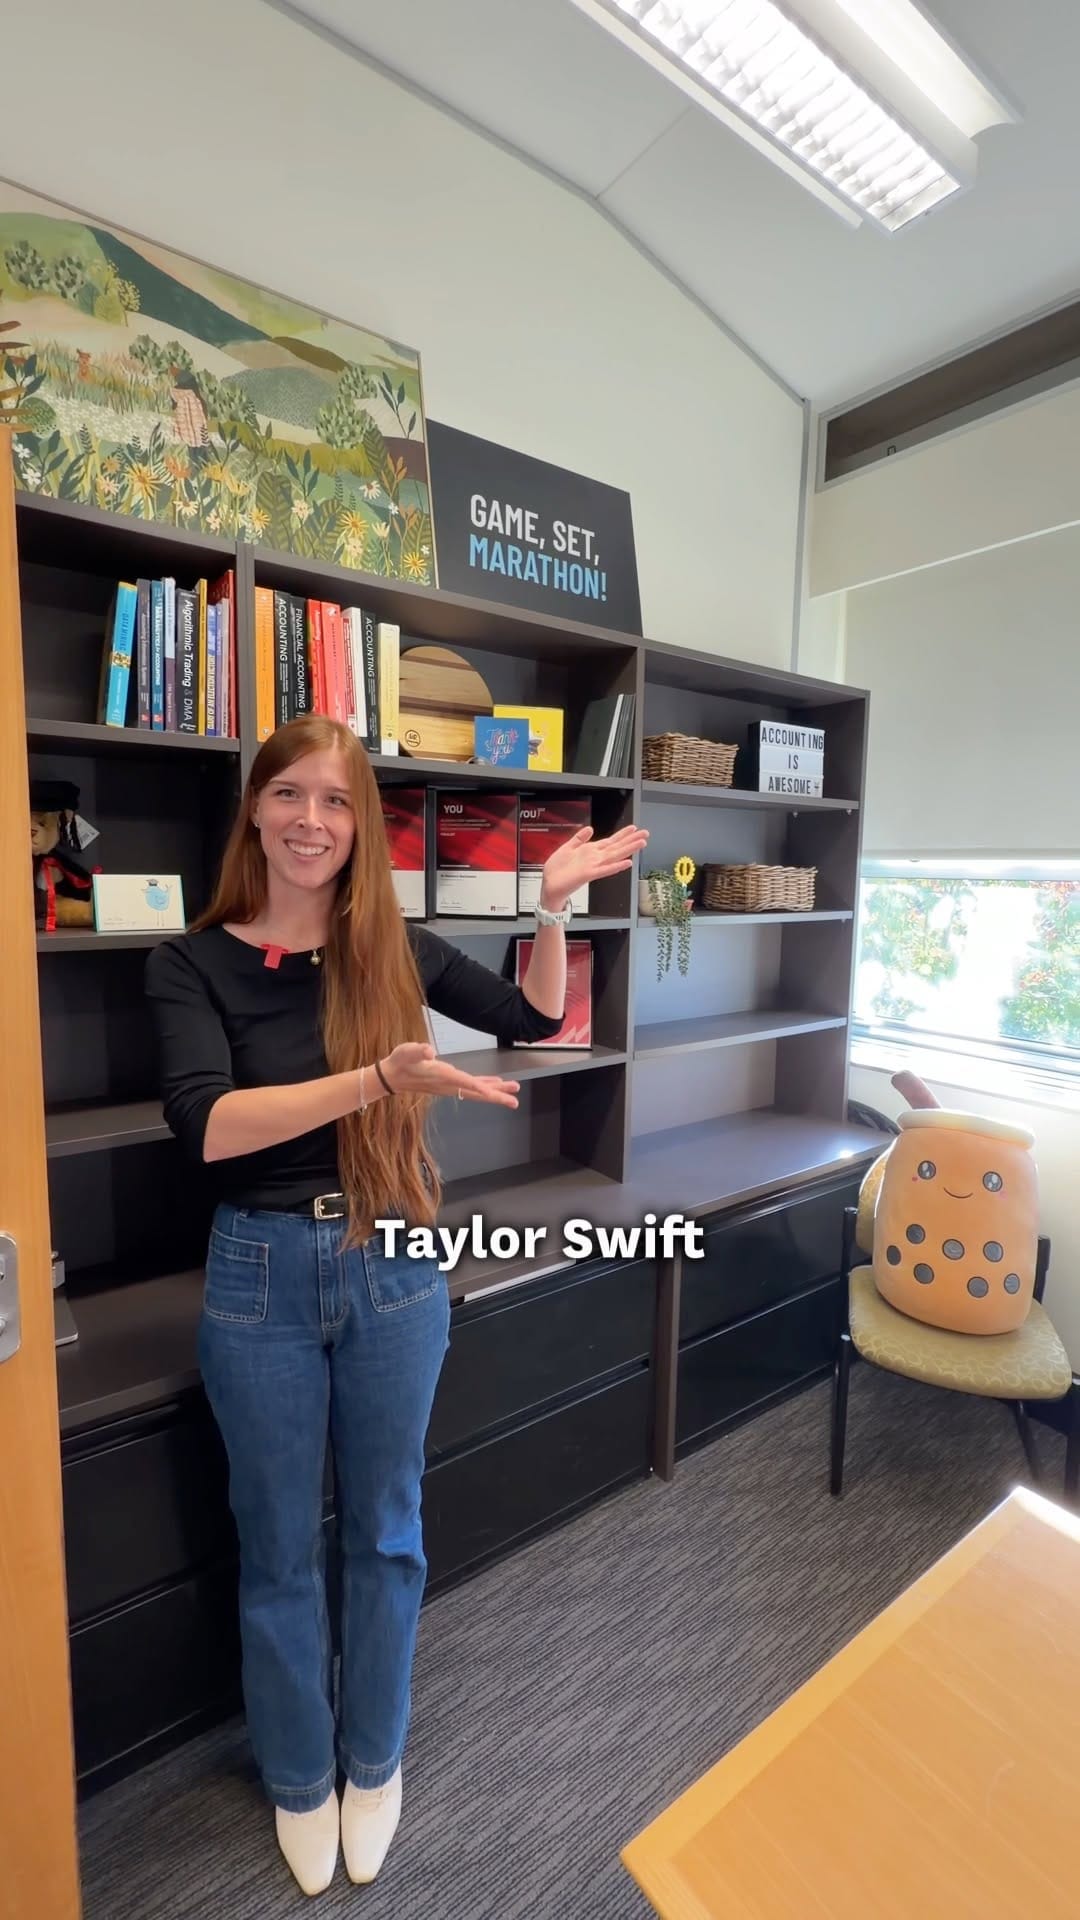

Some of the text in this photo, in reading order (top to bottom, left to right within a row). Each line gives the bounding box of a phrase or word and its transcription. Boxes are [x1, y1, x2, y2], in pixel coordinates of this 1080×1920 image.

[470, 494, 600, 566] GAME, SET,
[469, 533, 607, 602] MARATHON!
[182, 600, 194, 651] Algorithmic
[278, 598, 289, 662] ACCOUNTING
[365, 616, 375, 678] ACCOUNTING
[181, 652, 194, 687] Trading
[295, 608, 306, 709] FINANCIAL ACCOUNTING
[183, 698, 194, 721] DMA
[761, 727, 824, 750] ACCOUNTING
[788, 754, 799, 770] IS
[768, 775, 812, 795] AWESOME
[443, 804, 464, 814] YOU
